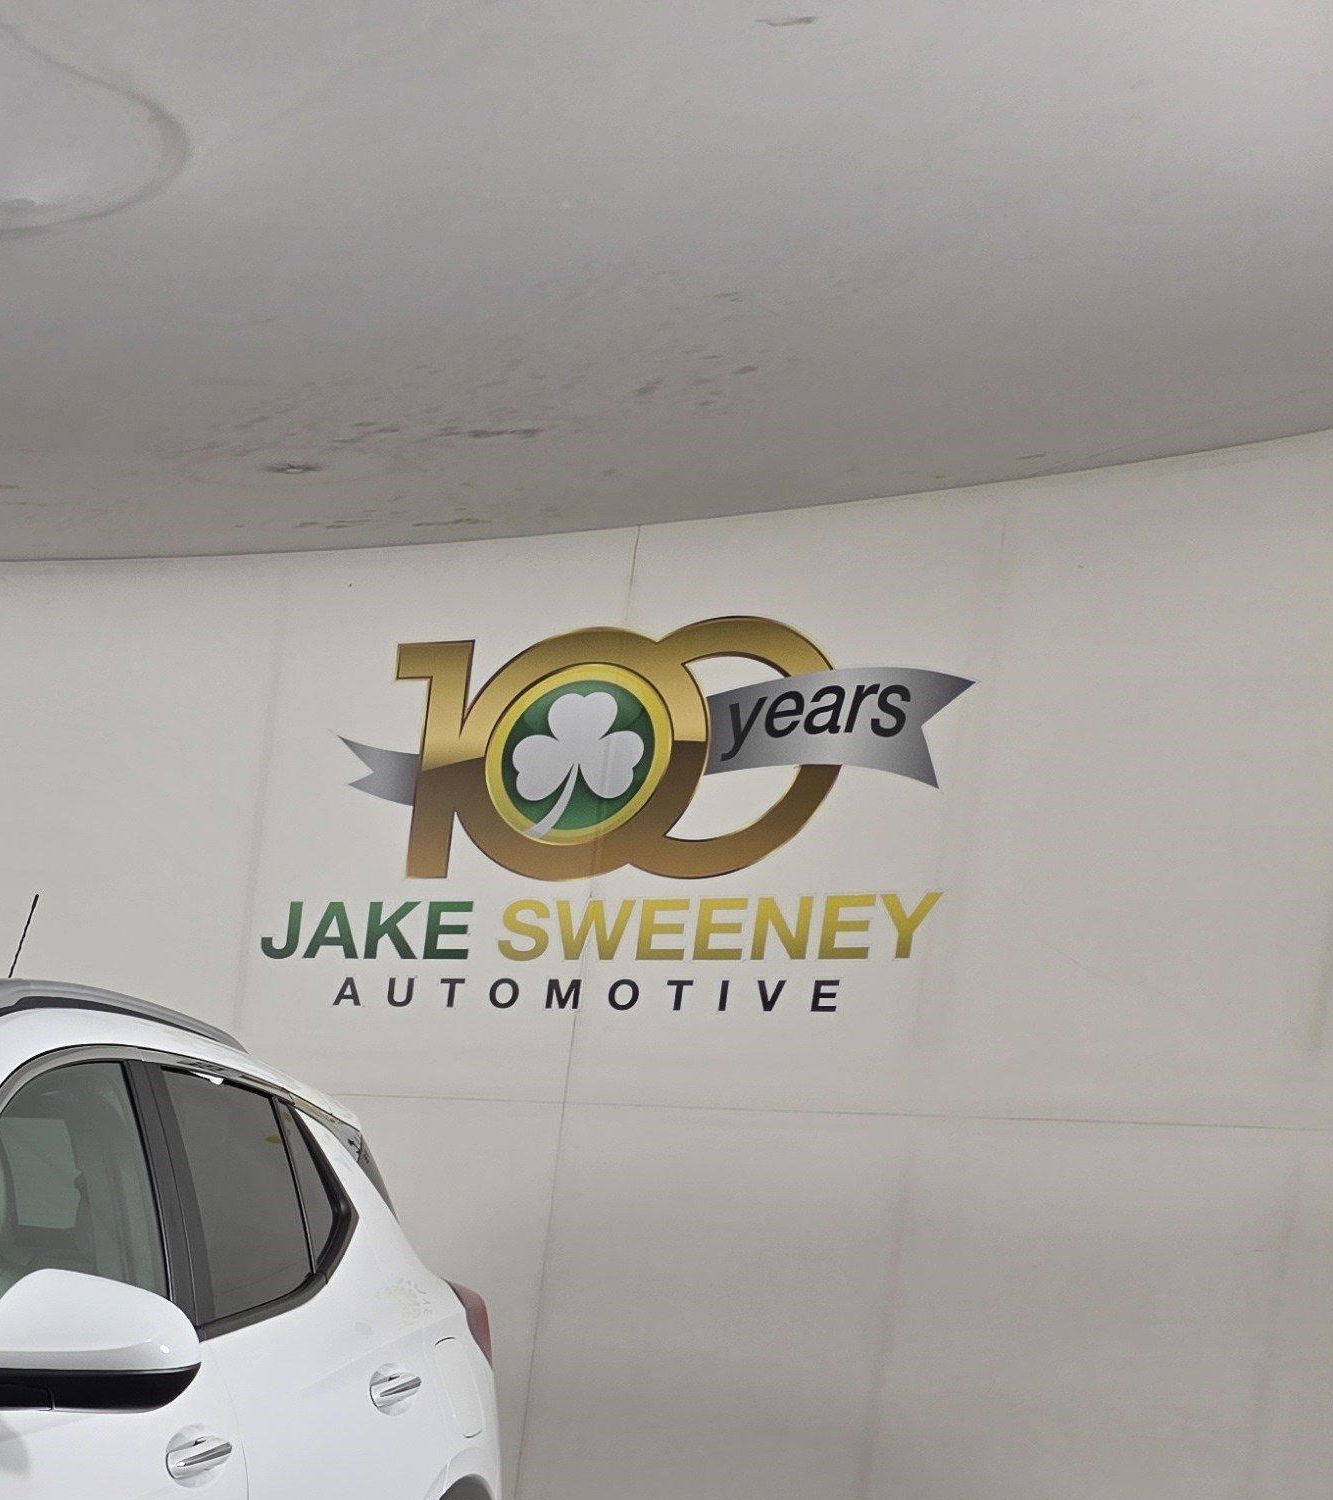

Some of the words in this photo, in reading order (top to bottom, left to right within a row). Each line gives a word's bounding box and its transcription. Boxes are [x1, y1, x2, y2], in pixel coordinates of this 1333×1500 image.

[394, 616, 841, 881] 100
[720, 681, 911, 761] years
[260, 900, 474, 960] JAKE
[497, 891, 944, 961] SWEENEY
[333, 976, 841, 1013] AUTOMOTIVE
